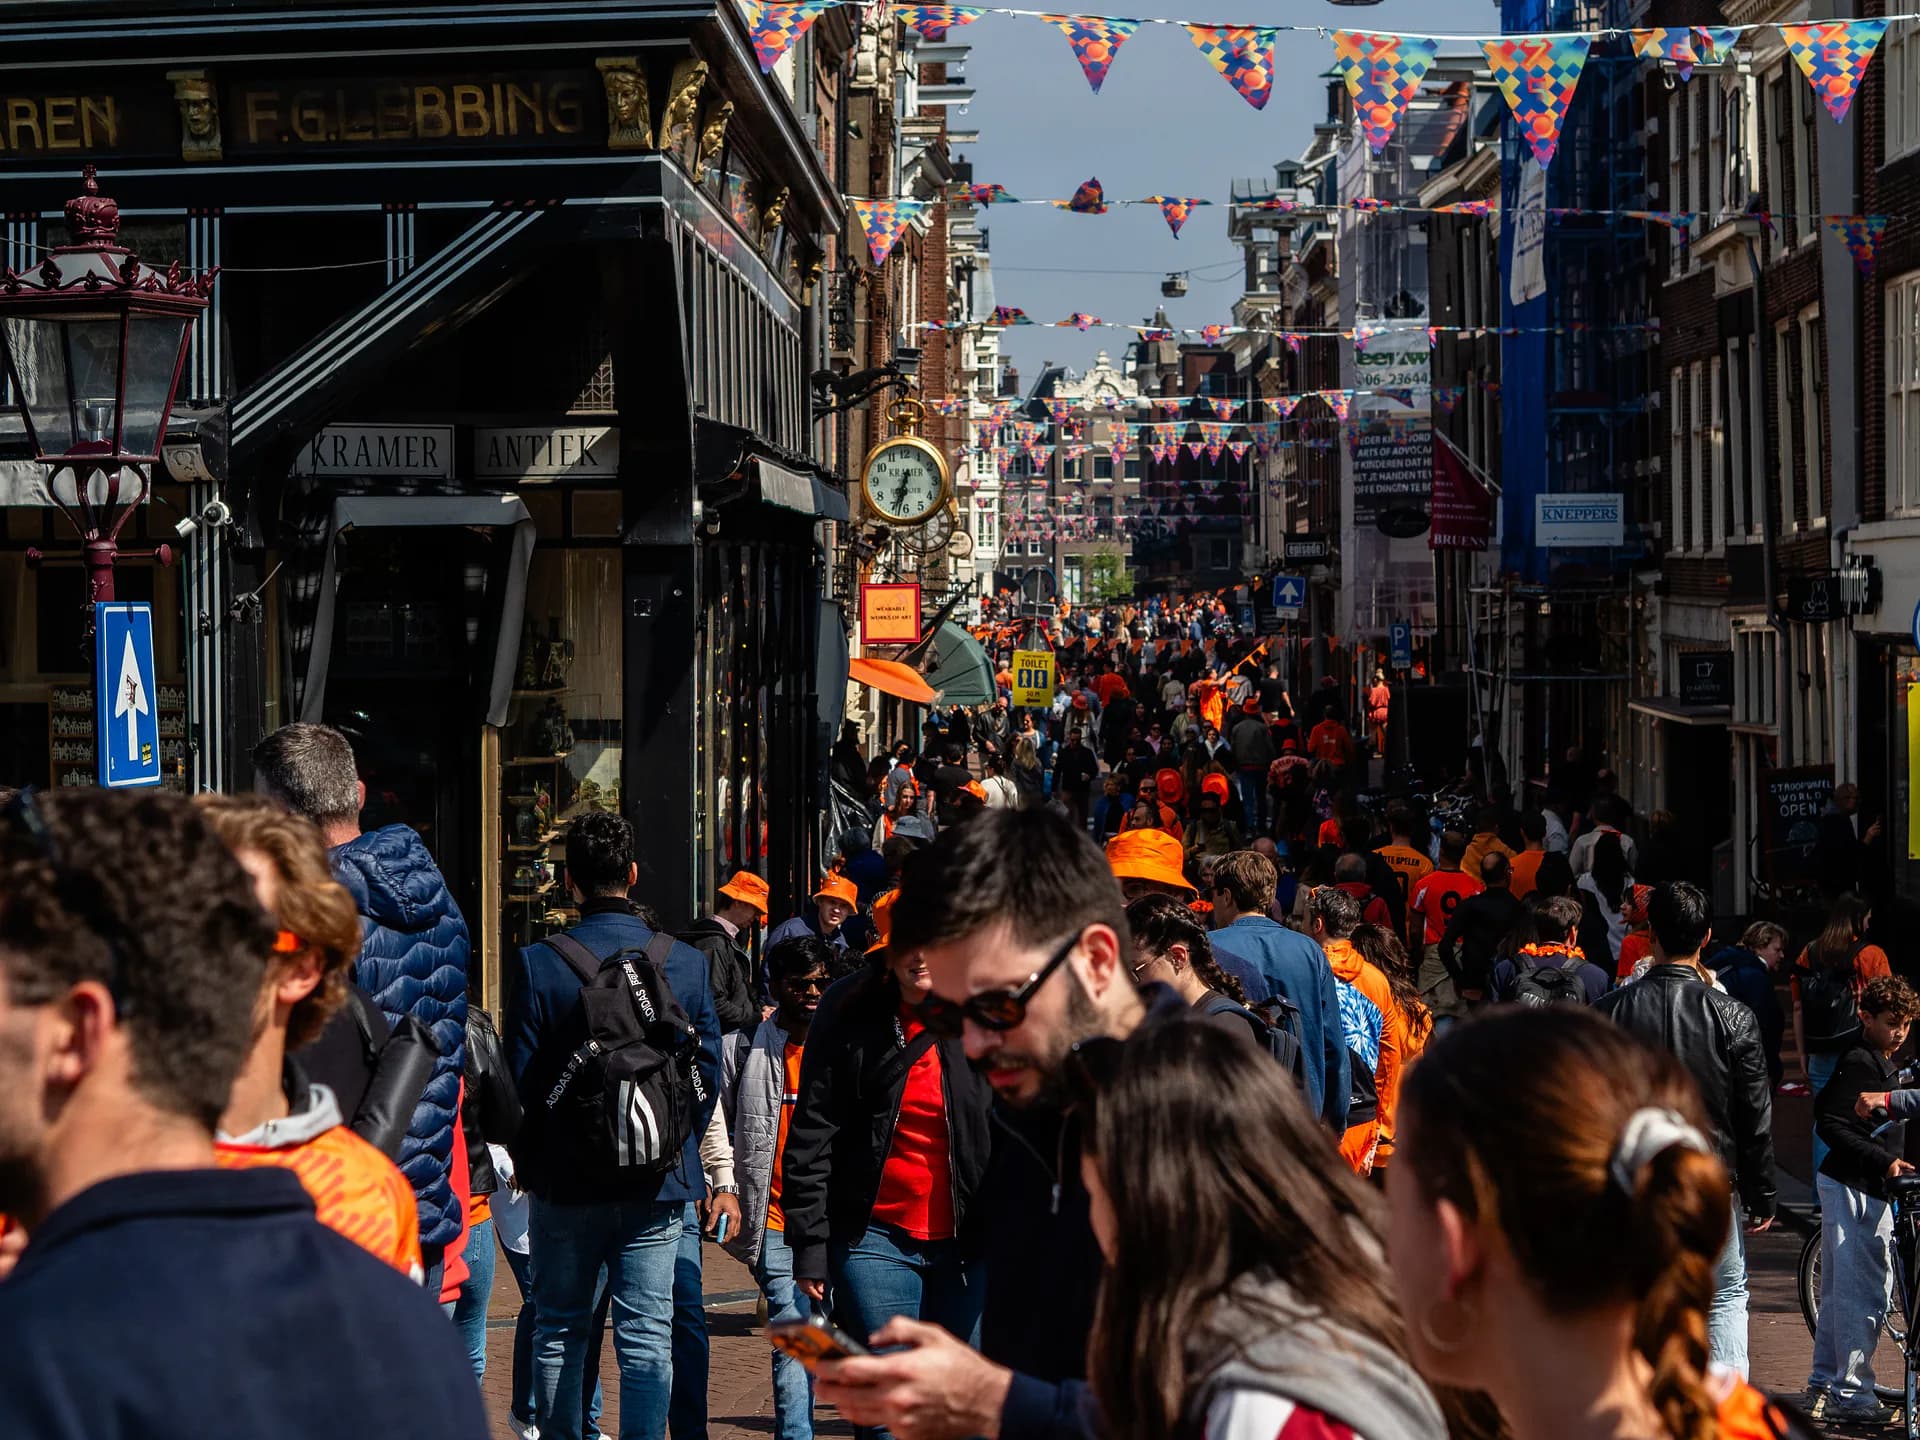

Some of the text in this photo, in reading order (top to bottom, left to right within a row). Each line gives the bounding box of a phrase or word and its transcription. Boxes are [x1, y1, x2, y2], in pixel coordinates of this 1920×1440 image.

[0, 96, 116, 150] REN
[312, 435, 597, 468] KRAMER ANTIEK
[900, 450, 910, 459] 12
[877, 463, 887, 473] 10
[1542, 508, 1618, 521] KNEPPERS
[1434, 533, 1487, 546] BRUENS
[1288, 542, 1321, 557] episode
[1393, 626, 1406, 646] P
[1020, 659, 1049, 669] TOILET
[1780, 800, 1818, 817] OPEN
[635, 989, 656, 1023] ADIDAS
[546, 1071, 573, 1109] ADIDAS
[691, 1065, 707, 1102] ADIDAS
